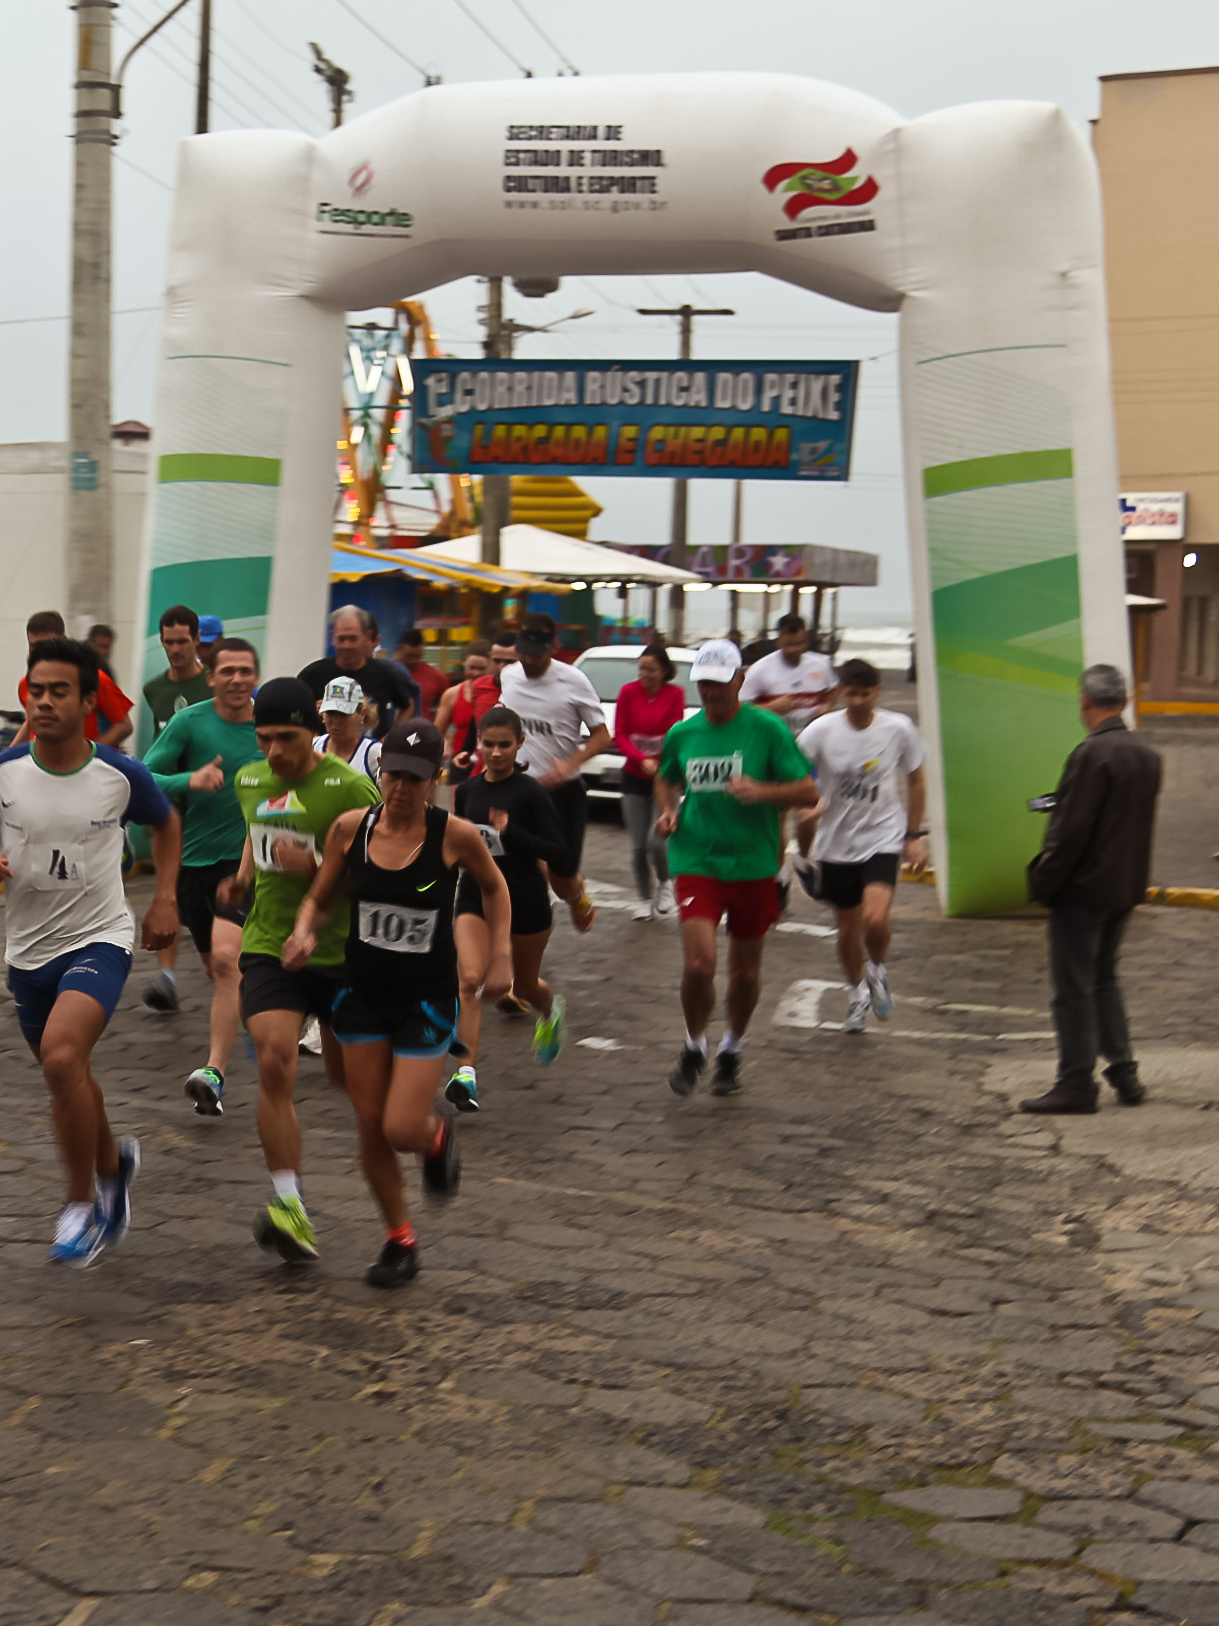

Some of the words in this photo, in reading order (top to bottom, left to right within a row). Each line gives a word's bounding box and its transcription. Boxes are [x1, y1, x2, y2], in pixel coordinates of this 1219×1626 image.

[507, 125, 598, 141] SECRETARIA
[604, 125, 623, 141] DE
[504, 149, 561, 167] ESTADO
[567, 149, 585, 167] DE
[503, 175, 571, 193] CULTURA
[576, 176, 585, 193] E
[588, 176, 658, 194] ESPORTE
[317, 202, 412, 229] Fesporte
[455, 370, 578, 413] CORRIDA
[583, 365, 708, 408] RÚSTICA
[713, 371, 755, 411] DO
[760, 372, 842, 421] PEIXE
[469, 423, 609, 465] LARGADA
[614, 425, 639, 466] E
[645, 425, 791, 468] CHEGADA
[368, 908, 430, 946] 105
